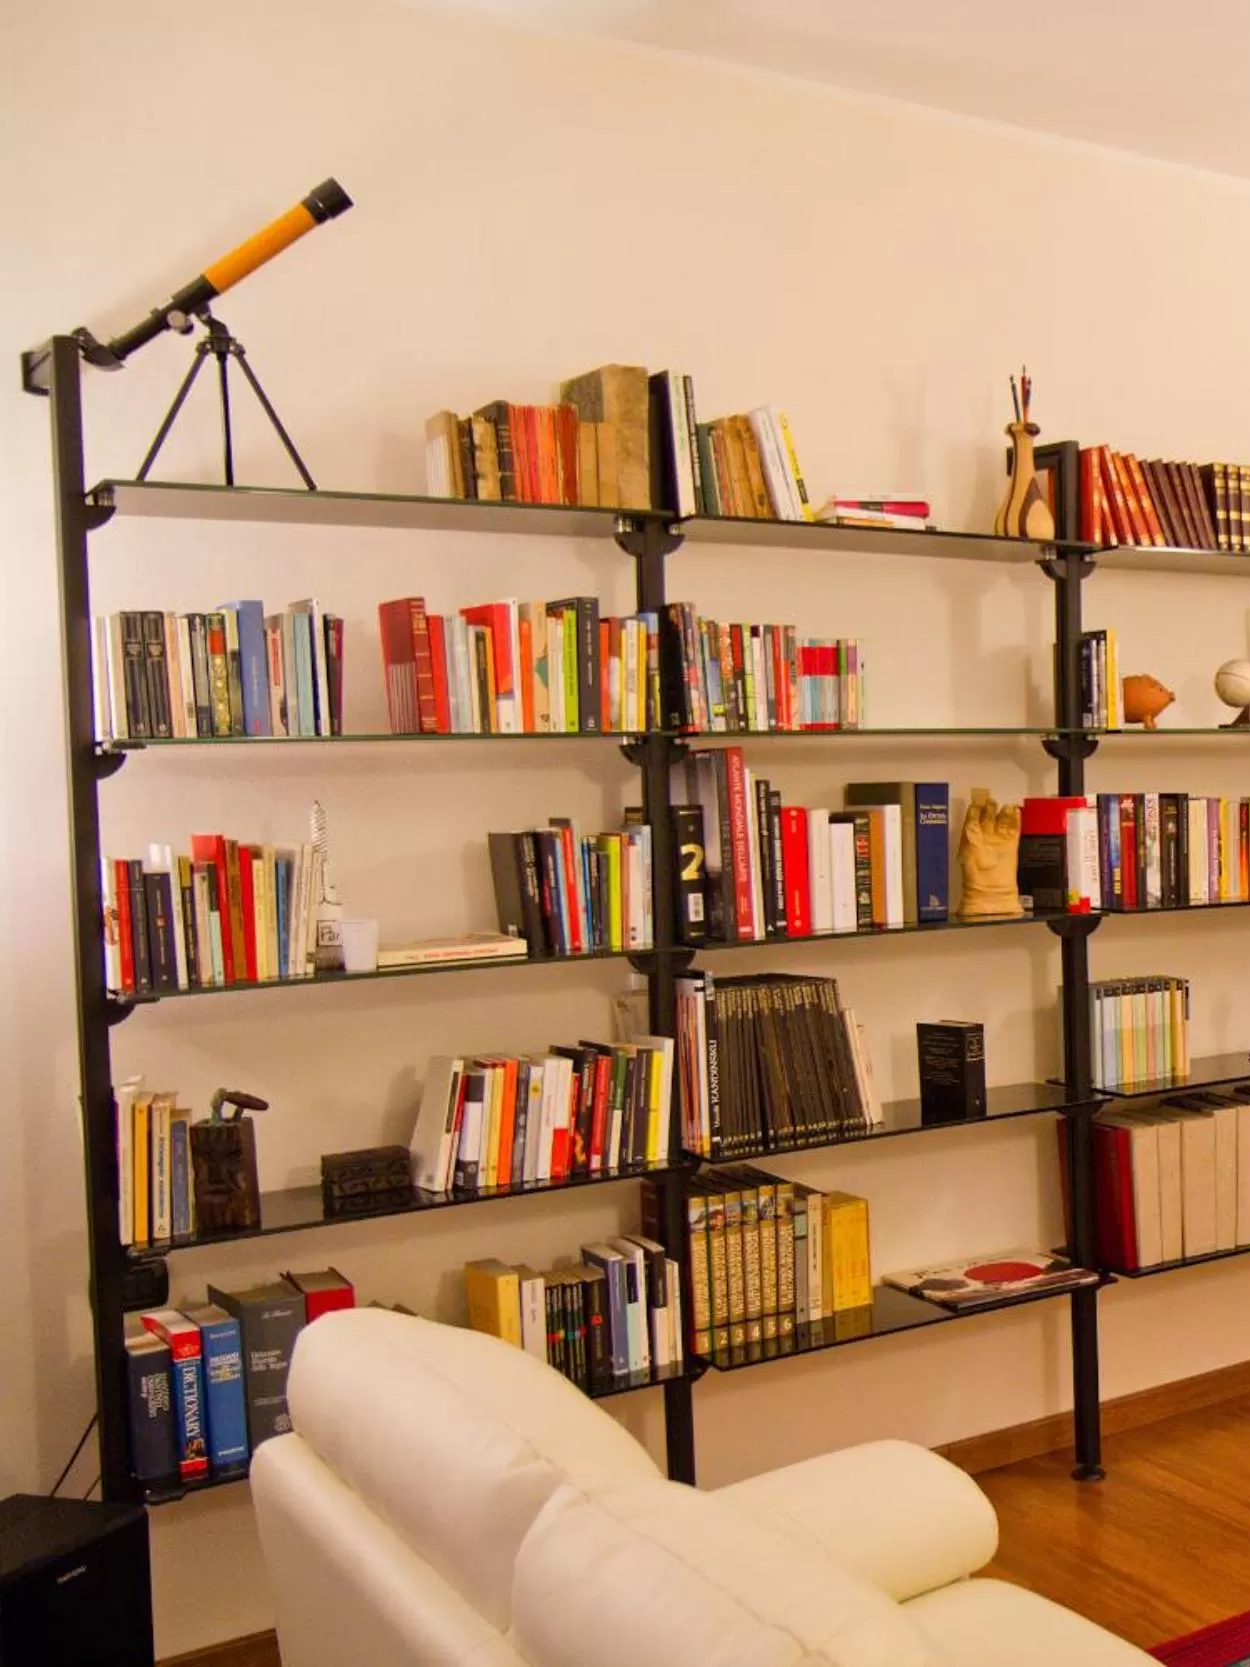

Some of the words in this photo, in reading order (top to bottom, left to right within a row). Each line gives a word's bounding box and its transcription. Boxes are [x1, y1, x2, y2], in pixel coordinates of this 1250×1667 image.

[681, 843, 704, 881] 2
[783, 1317, 792, 1331] 6
[720, 1331, 728, 1345] 2
[183, 1367, 199, 1438] DICTIONARY
